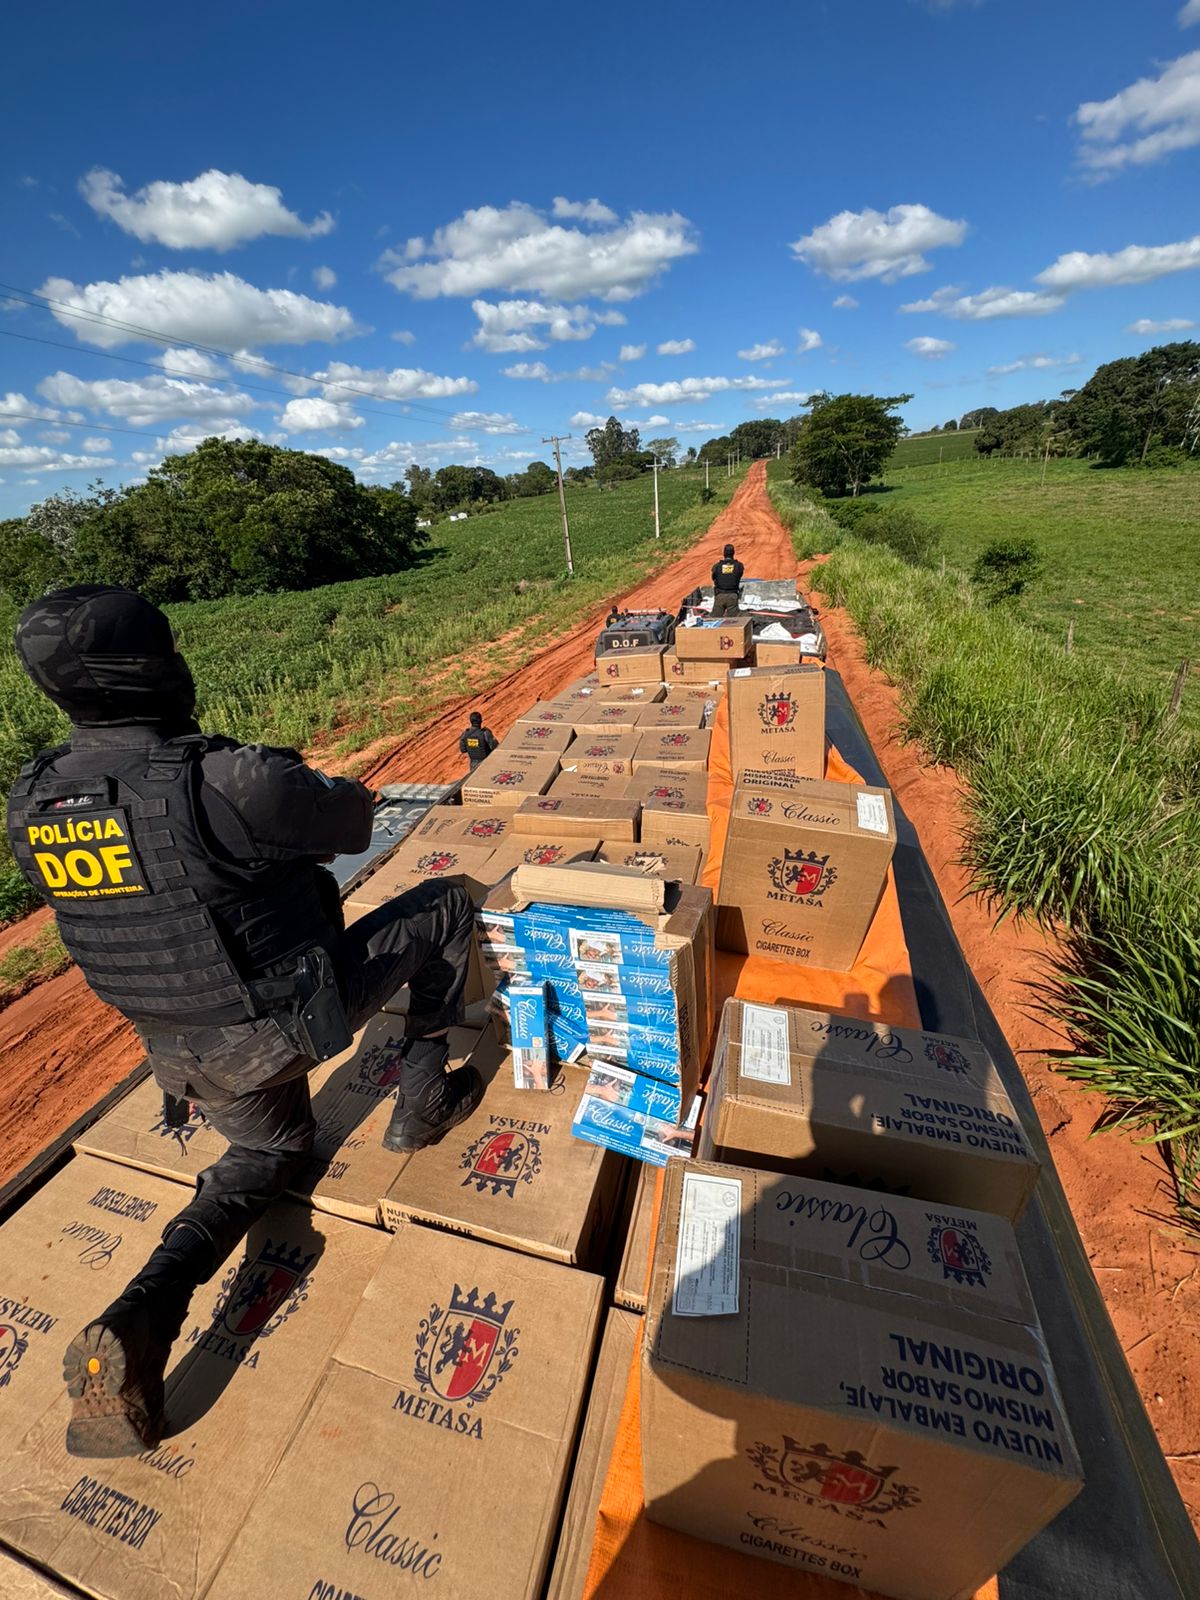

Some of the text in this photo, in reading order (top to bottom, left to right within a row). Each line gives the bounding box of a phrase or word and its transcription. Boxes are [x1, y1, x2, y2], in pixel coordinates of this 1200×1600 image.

[761, 726, 796, 735] METASA
[761, 750, 796, 764] Classic
[743, 778, 796, 789] ORIGINAL
[781, 801, 840, 825] Classic
[27, 817, 125, 845] POLÍCIA
[34, 844, 133, 888] DOF
[100, 885, 145, 896] FRONTEIRA
[766, 890, 824, 908] METASA
[524, 928, 567, 951] Classic
[761, 918, 815, 942] Classic
[755, 940, 811, 959] CIGARETTES BOX
[517, 998, 538, 1040] Classic
[810, 1020, 914, 1063] Classic
[489, 1114, 552, 1135] METASA
[588, 1104, 635, 1133] Classic
[904, 1093, 1014, 1128] ORIGINAL
[966, 1134, 1028, 1157] NUEVO
[87, 1185, 116, 1208] BOX
[386, 1207, 421, 1222] NUEVO
[776, 1191, 911, 1270] Classic
[925, 1212, 978, 1231] METASA
[59, 1221, 123, 1270] Classic
[0, 1296, 59, 1334] METAS
[185, 1326, 260, 1369] METASA
[889, 1333, 1045, 1397] ORIGINAL
[392, 1390, 484, 1440] METASA
[839, 1381, 1064, 1465] NUEVO EMBALAJE,
[60, 1475, 163, 1550] CIGARETTES BOX
[752, 1481, 888, 1530] METASA
[345, 1481, 442, 1579] Classic
[746, 1510, 868, 1562] Classic
[739, 1532, 863, 1579] CIGARETTES BOX
